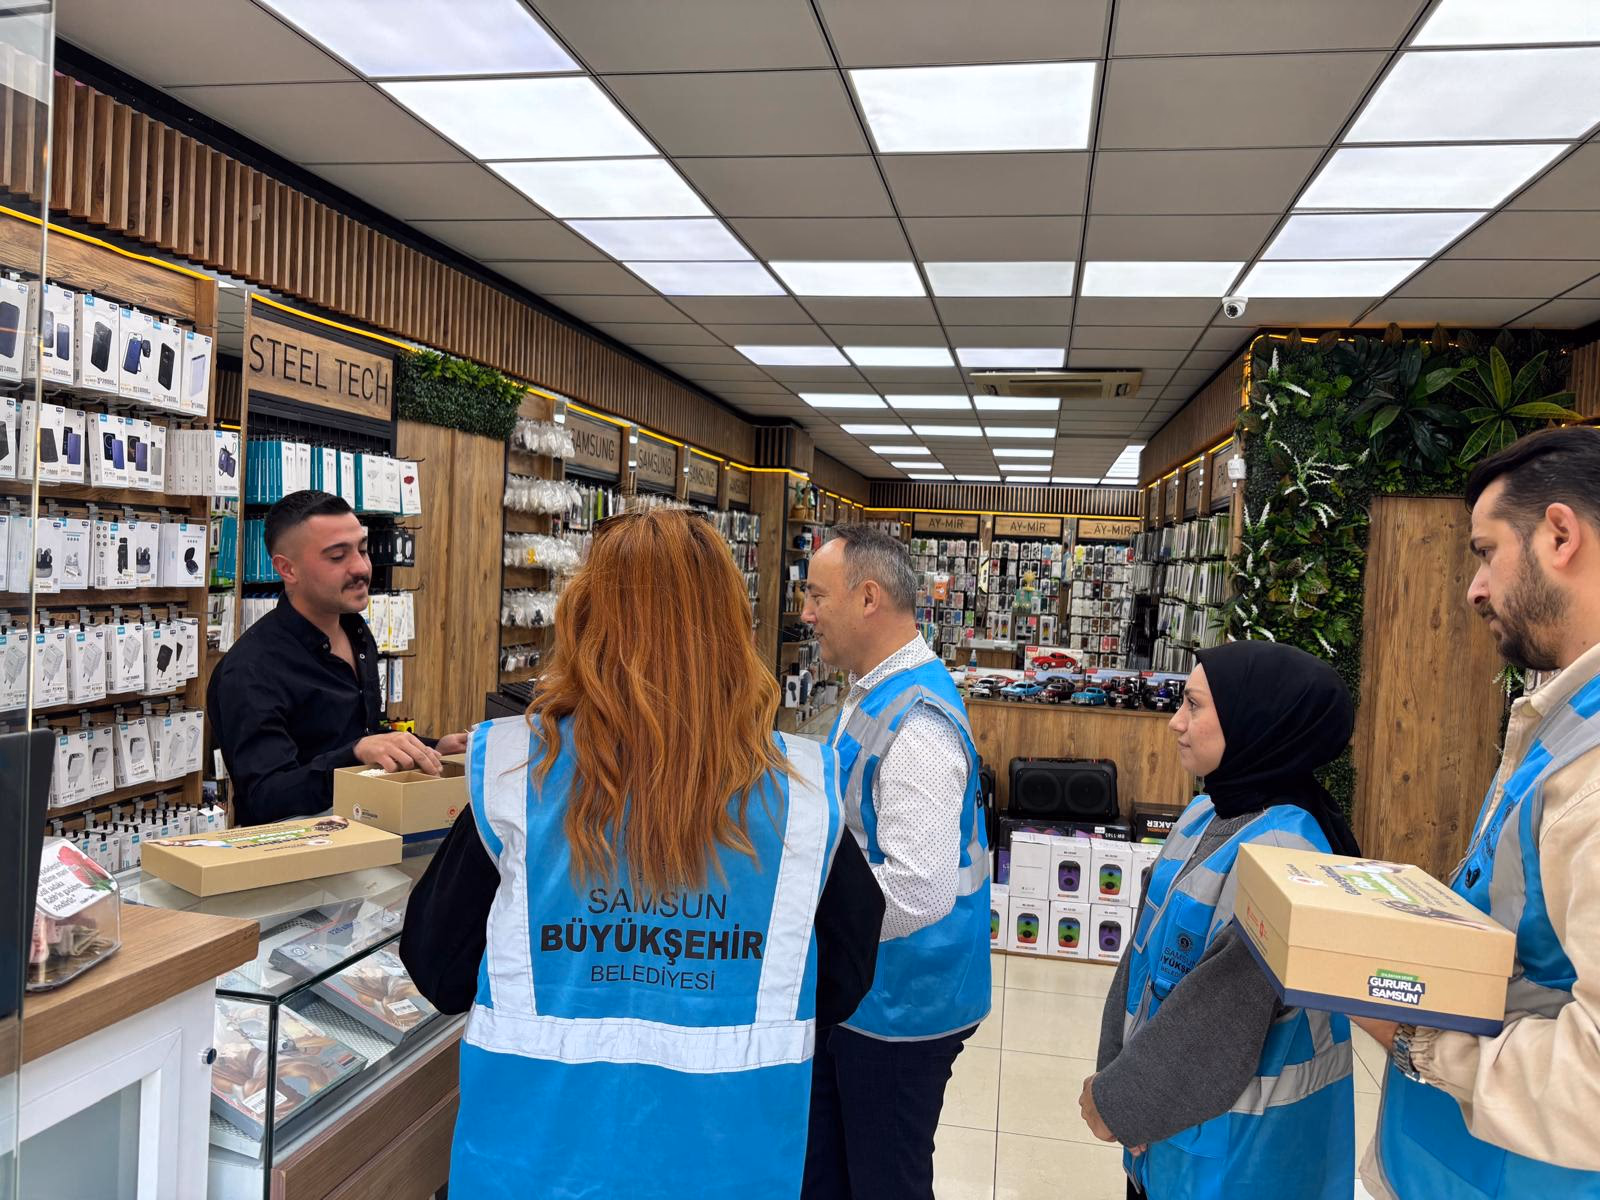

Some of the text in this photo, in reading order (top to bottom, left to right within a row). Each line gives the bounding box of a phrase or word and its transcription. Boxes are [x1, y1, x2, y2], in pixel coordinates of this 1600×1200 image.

[249, 333, 388, 407] STEEL TECH
[638, 449, 672, 475] SAMSUNG
[928, 514, 964, 528] AY-MİR
[1010, 520, 1046, 533] AY-MİR
[588, 888, 727, 919] SAMSUN
[541, 917, 763, 966] BÜYÜKŞEHİR
[591, 965, 715, 991] BELEDİYESİ
[1370, 977, 1423, 993] GURURLA
[1372, 988, 1418, 1004] SAMSUN
